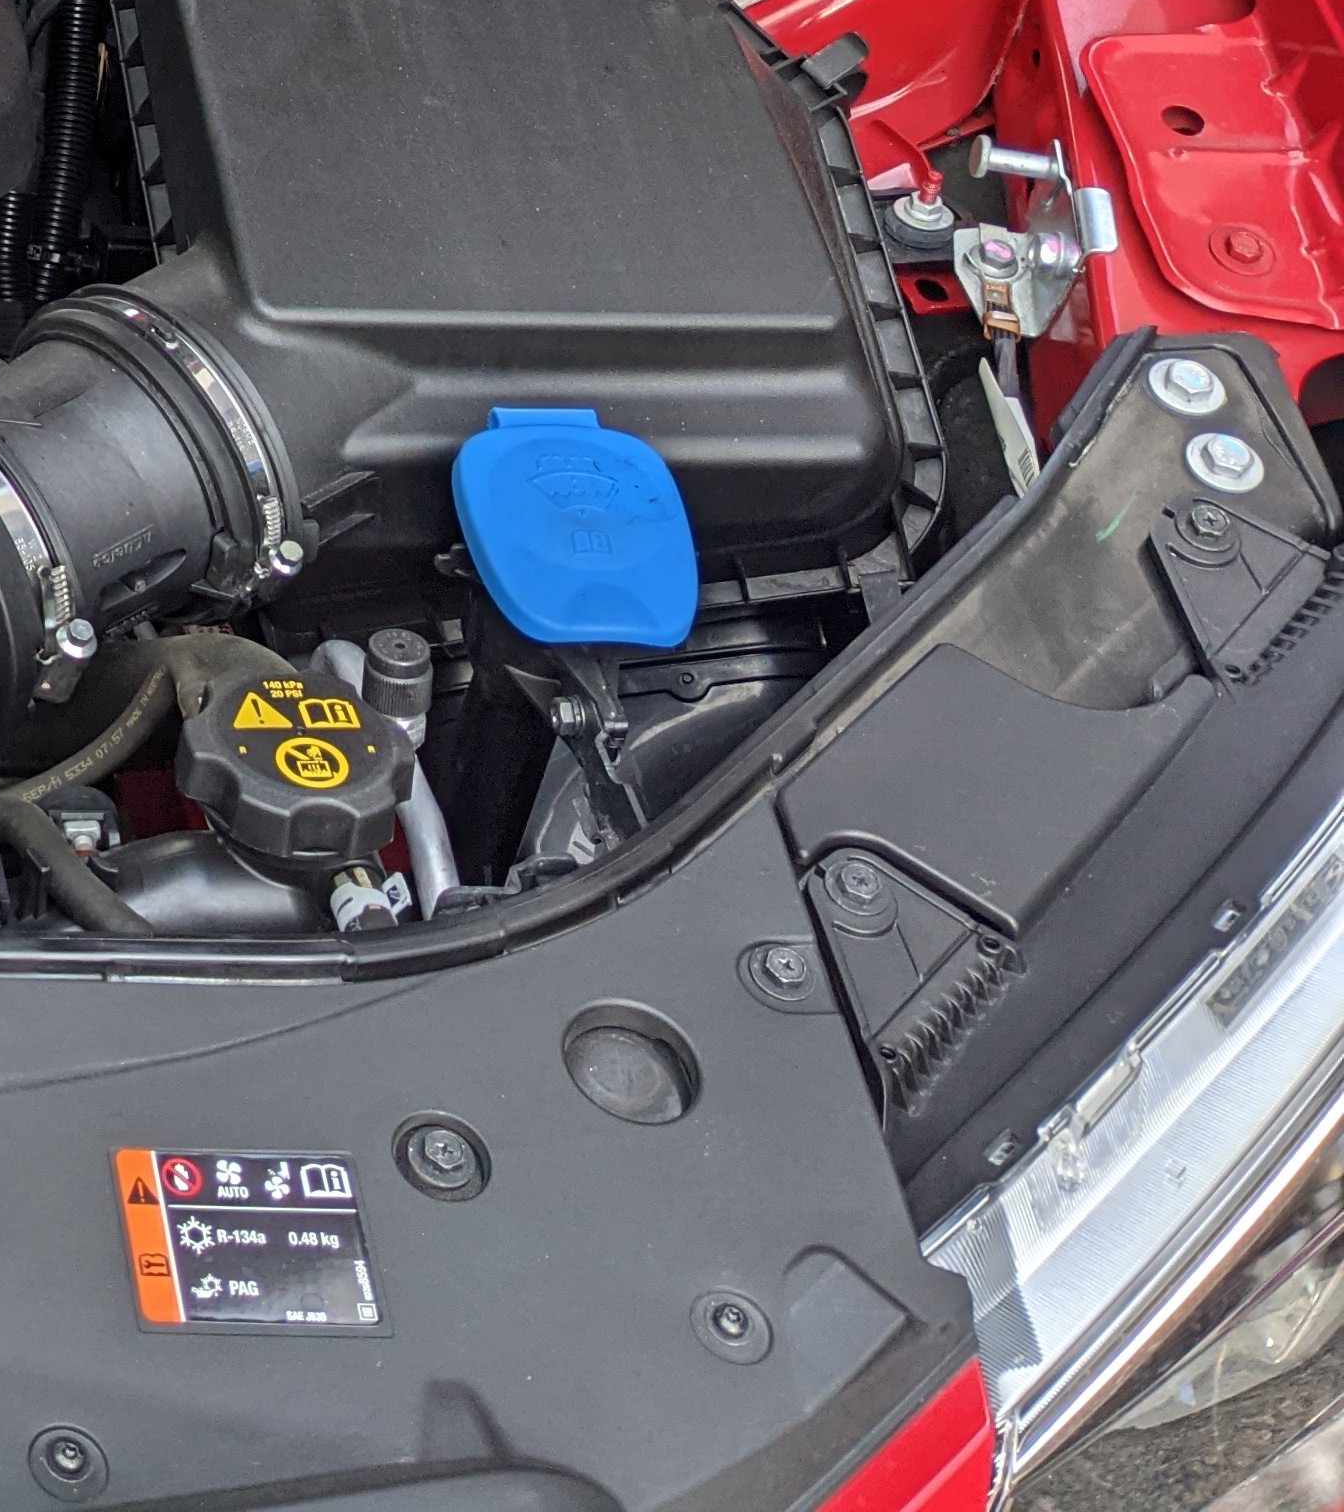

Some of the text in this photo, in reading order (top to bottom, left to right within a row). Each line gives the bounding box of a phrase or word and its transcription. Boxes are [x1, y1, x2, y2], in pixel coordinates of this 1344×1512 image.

[263, 680, 304, 690] 140 kPa
[270, 689, 304, 699] 20 PSI
[217, 1185, 250, 1199] AUTO
[216, 1229, 340, 1249] R-134a 0.48 kg
[229, 1280, 260, 1296] PAG
[286, 1310, 305, 1321] SAE
